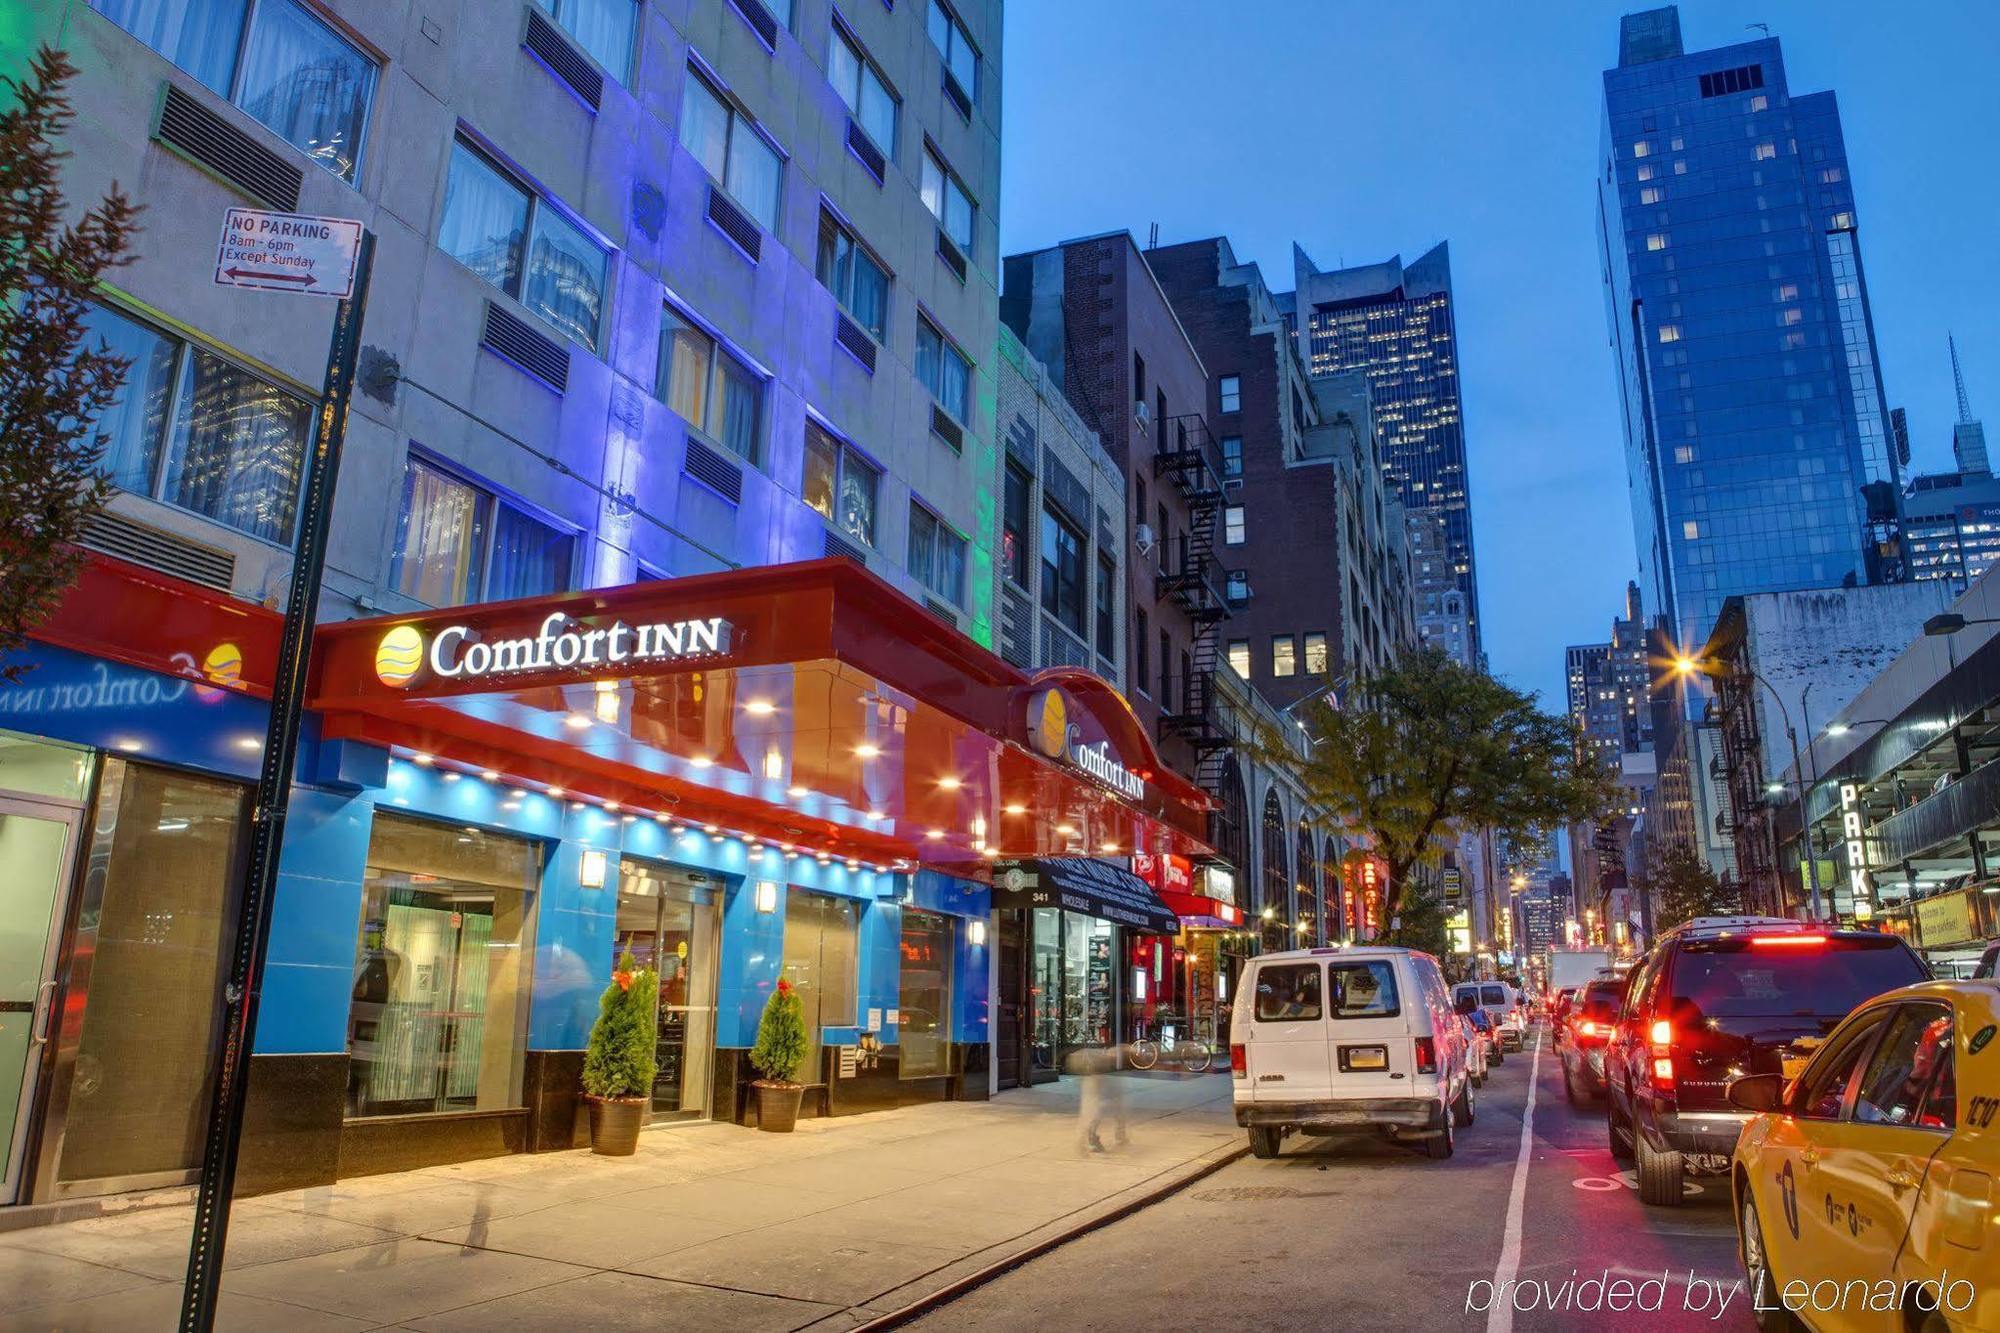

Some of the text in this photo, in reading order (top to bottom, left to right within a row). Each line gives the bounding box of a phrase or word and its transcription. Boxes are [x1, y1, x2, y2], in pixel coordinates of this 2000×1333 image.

[232, 216, 330, 240] NO PARKING
[229, 234, 256, 247] 8am
[268, 238, 294, 252] 6pm
[226, 249, 315, 270] Except Sunday
[430, 612, 726, 677] Comfort INN
[1066, 722, 1145, 801] Comfort INN
[1840, 783, 1870, 896] PARK
[1032, 892, 1049, 903] 341
